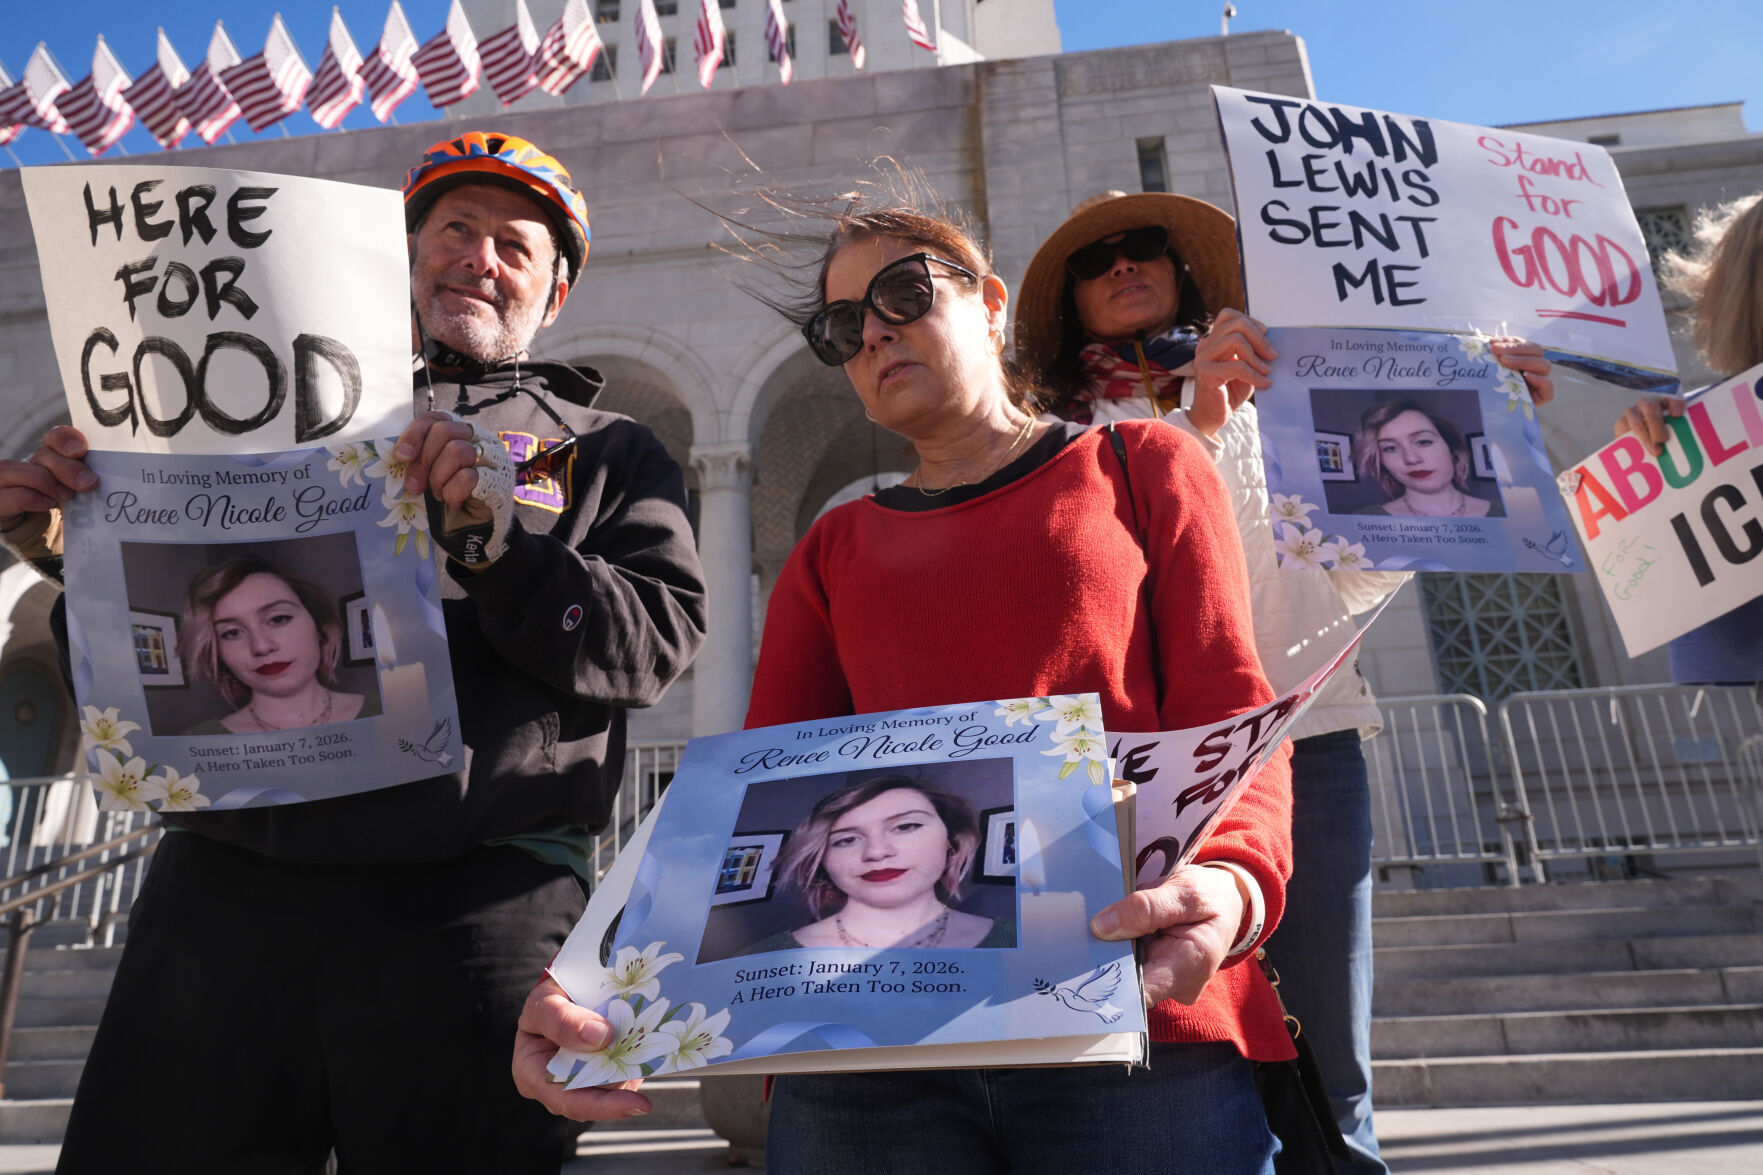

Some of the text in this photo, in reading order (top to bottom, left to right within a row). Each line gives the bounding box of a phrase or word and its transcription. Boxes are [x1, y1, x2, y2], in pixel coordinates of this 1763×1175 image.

[1244, 95, 1438, 168] JOHN
[1266, 148, 1440, 207] LEWIS
[1477, 136, 1606, 188] Stand
[83, 179, 279, 249] HERE
[1516, 174, 1584, 219] for
[1260, 200, 1438, 258] SENT
[1333, 258, 1426, 307] ME
[1492, 216, 1642, 308] GOOD
[115, 256, 259, 322] FOR
[1296, 355, 1489, 386] Renee Nicole Good
[1331, 340, 1448, 354] In Loving Memory of
[81, 326, 362, 443] GOOD
[141, 464, 311, 488] In Loving Memory of
[104, 484, 372, 533] Renee Nicole Good
[1358, 522, 1397, 532] Sunset:
[1400, 524, 1439, 533] January
[1670, 463, 1763, 587] IC
[1361, 534, 1488, 544] A Hero Taken Too Soon.
[189, 733, 352, 758] Sunset: January 7, 2026.
[734, 724, 1040, 774] Renee Nicole Good
[796, 711, 978, 740] In Loving Memory of
[194, 749, 357, 773] A Hero Taken Too Soon.
[730, 980, 968, 1005] A Hero Taken Too Soon.
[734, 961, 965, 984] Sunset: January 7, 2026.
